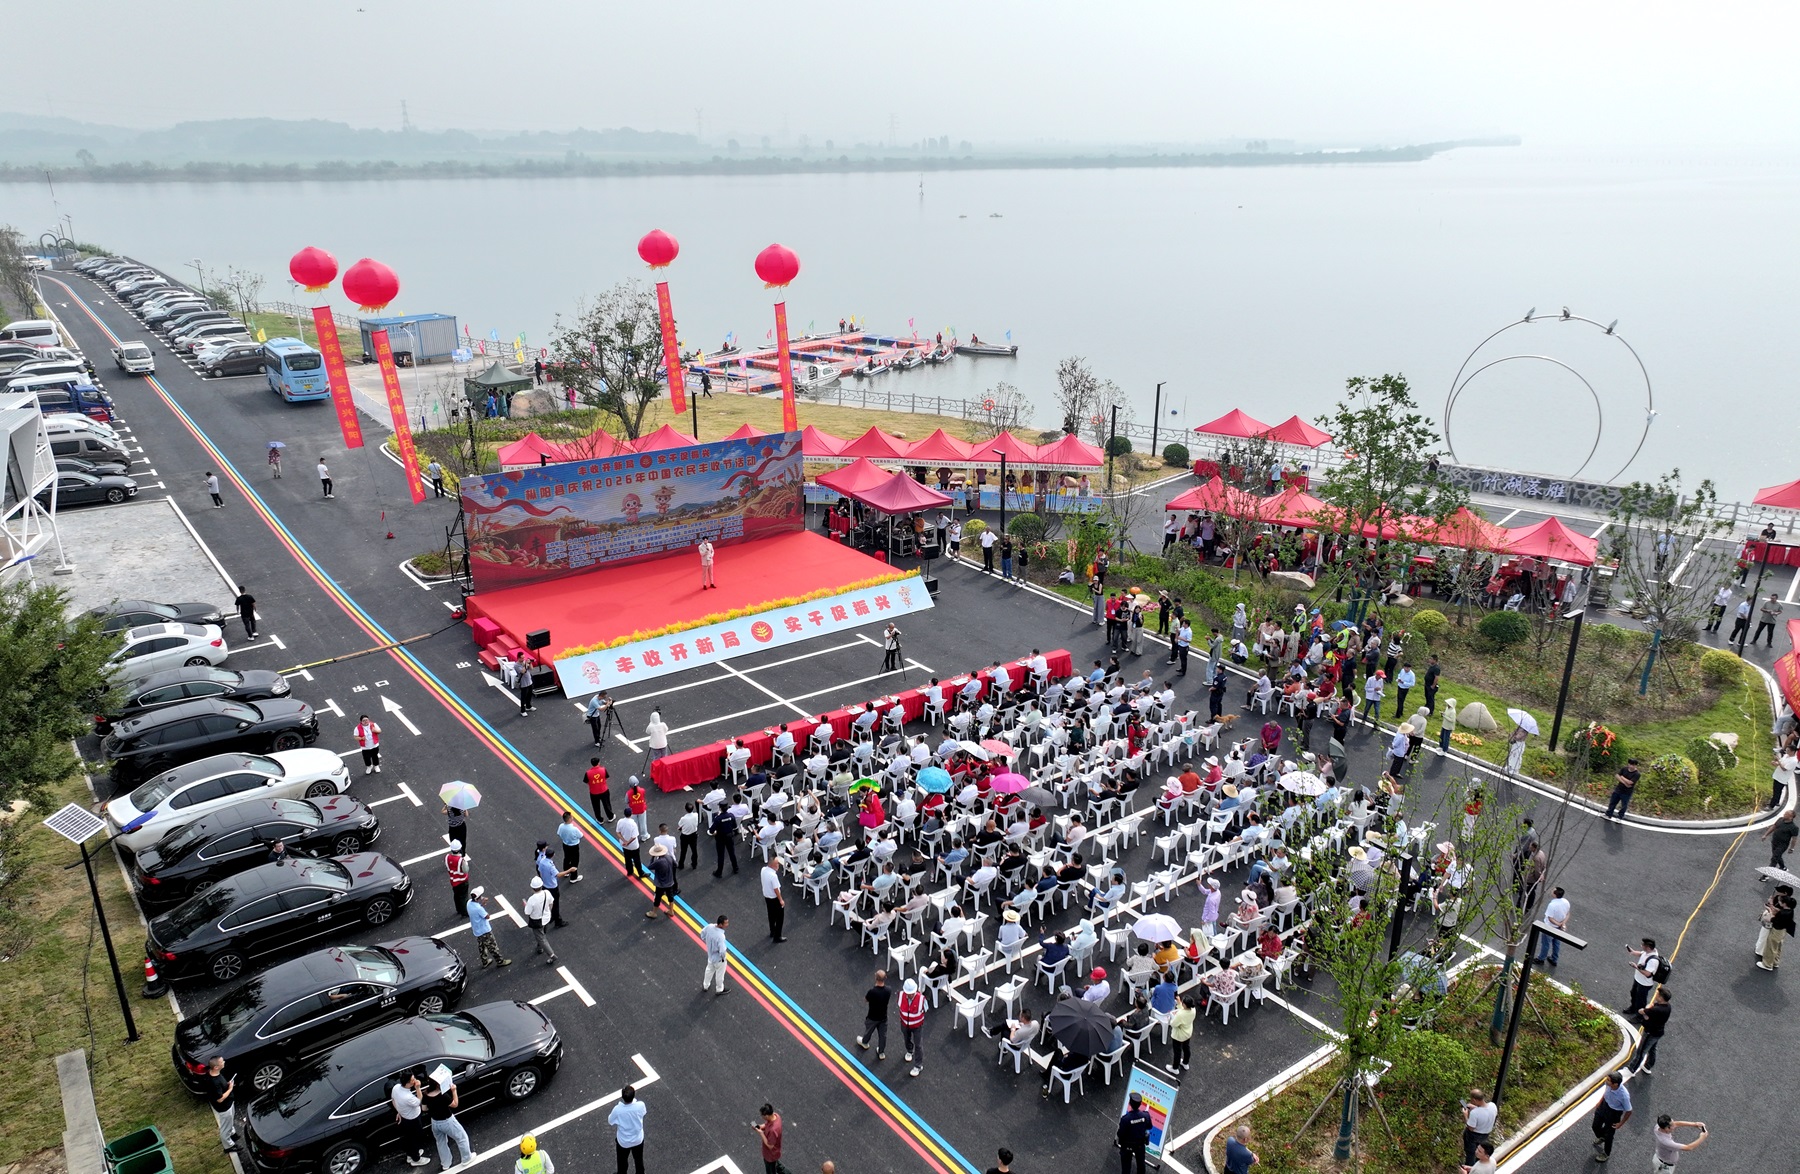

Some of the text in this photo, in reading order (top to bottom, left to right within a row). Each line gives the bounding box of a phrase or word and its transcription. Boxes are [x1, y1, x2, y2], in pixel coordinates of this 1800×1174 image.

[319, 317, 360, 440] 水乡庆丰收 实干兴枞阳
[378, 343, 404, 415] 品枞阳风物
[523, 455, 757, 501] 枞阳县庆祝2026年中国农民丰收节活动
[577, 448, 711, 476] 丰收开新局 实干促振兴
[1482, 474, 1566, 499] 竹湖落雁
[614, 594, 892, 675] 丰收开新局 实干促振兴
[351, 679, 390, 693] 出口
